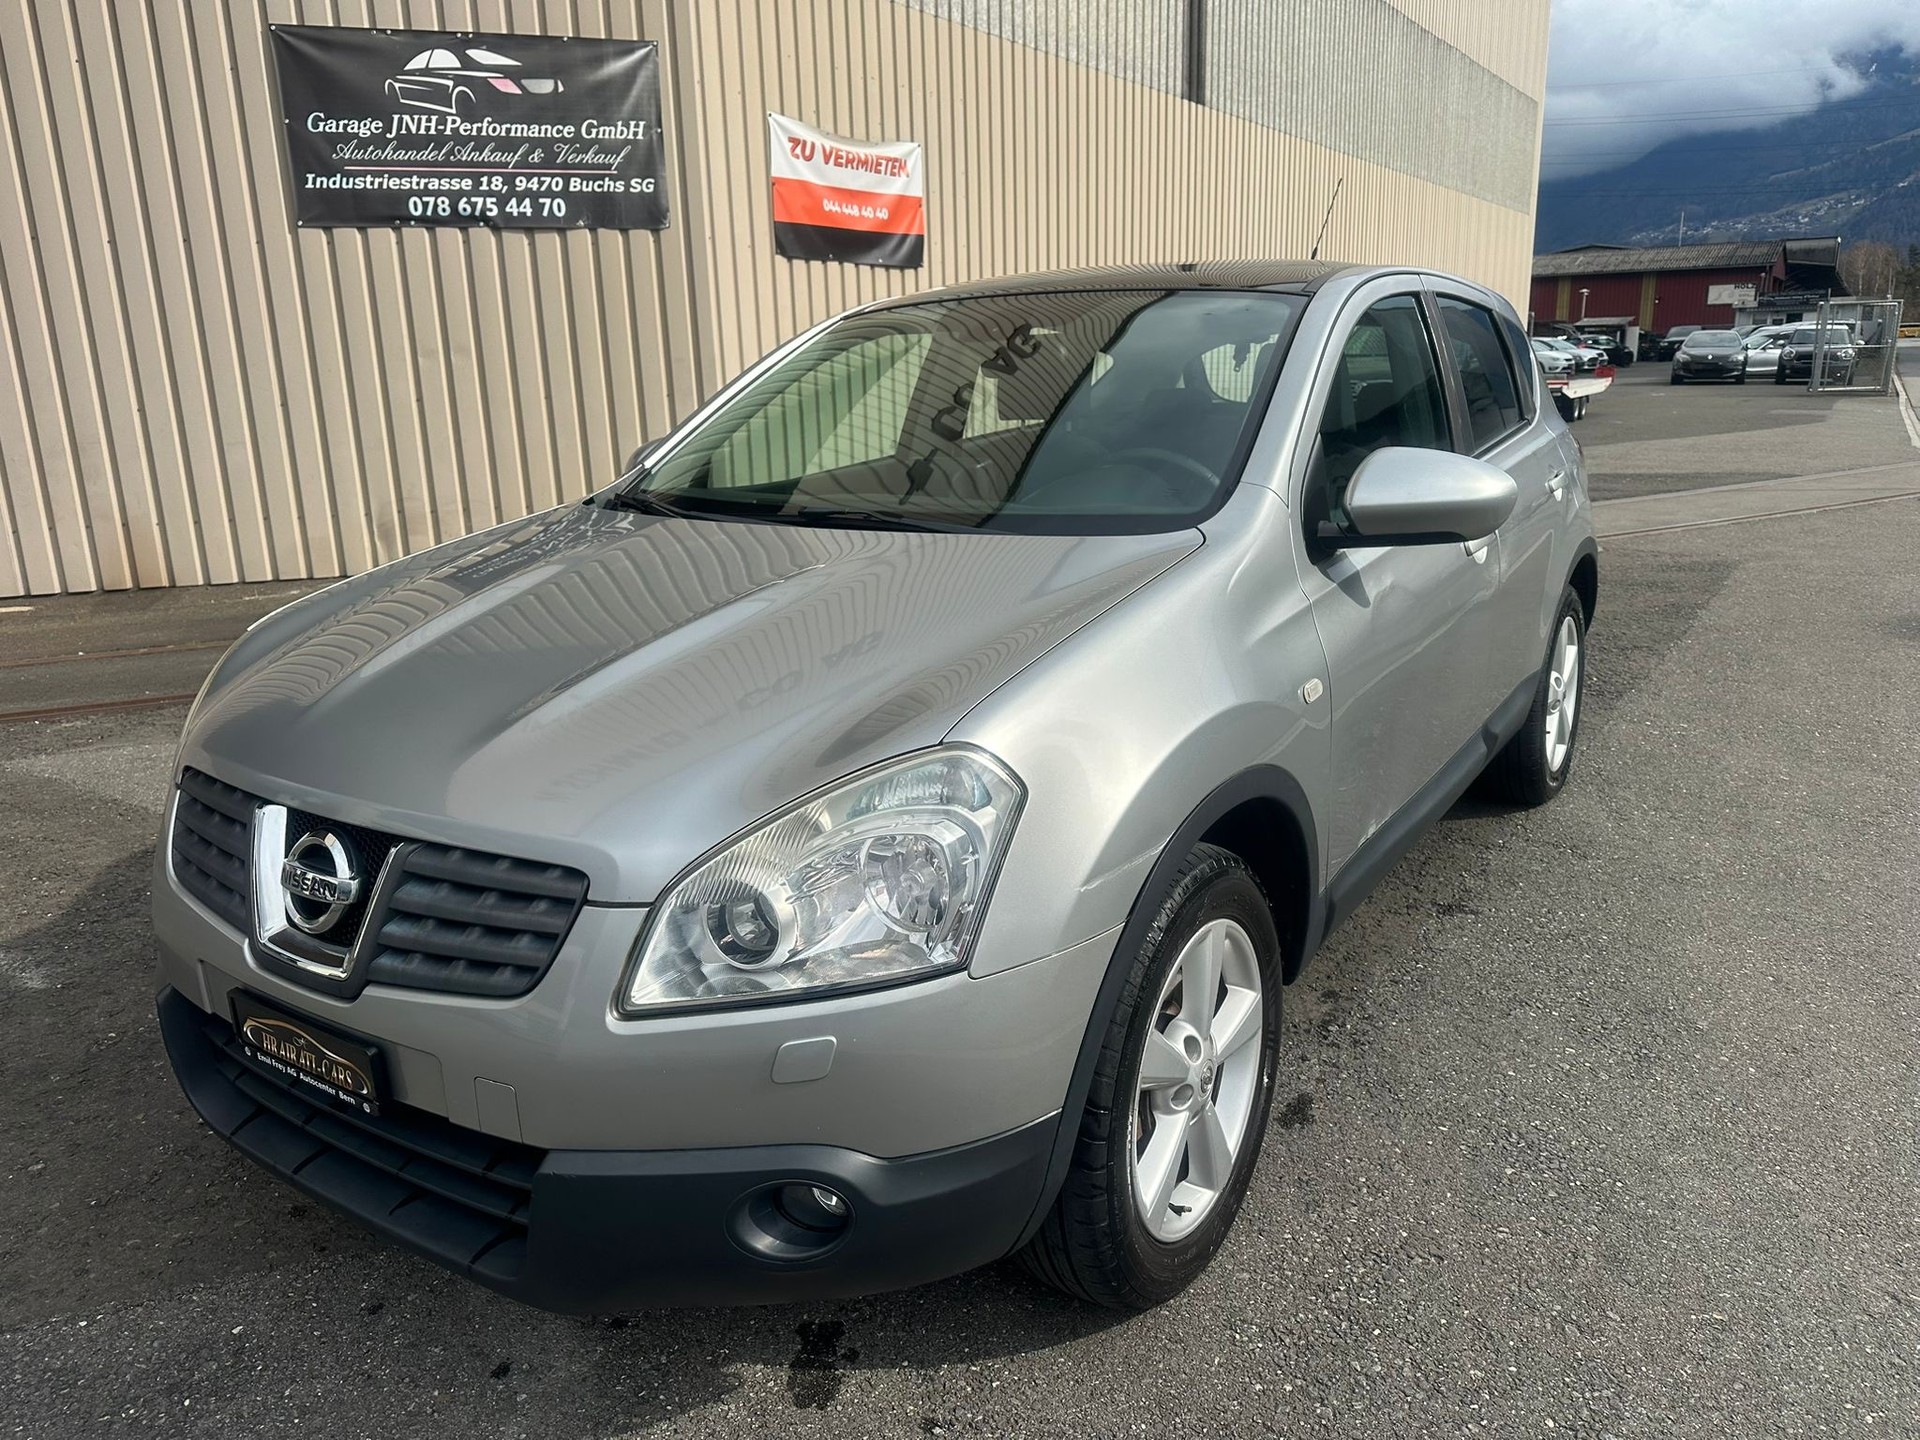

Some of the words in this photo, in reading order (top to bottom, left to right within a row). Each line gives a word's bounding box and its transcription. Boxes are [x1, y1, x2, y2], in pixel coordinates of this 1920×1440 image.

[306, 111, 383, 138] Garage
[386, 114, 576, 139] JNH-Performance
[581, 119, 646, 140] GmbH
[332, 139, 454, 162] Autohandel
[450, 141, 529, 169] Ankauf
[528, 148, 545, 163] &
[553, 143, 632, 170] Verkauf
[788, 136, 815, 162] ZU
[821, 143, 910, 178] VERMIETEN
[304, 173, 473, 190] Industriestrasse
[479, 175, 509, 194] 18,
[514, 177, 563, 192] 9470
[569, 177, 625, 193] Buchs
[629, 178, 656, 193] SG
[408, 196, 451, 216] 078
[457, 197, 499, 217] 675
[505, 197, 533, 217] 44
[539, 198, 566, 217] 70
[823, 198, 841, 213] 044
[842, 202, 859, 217] 448
[861, 205, 874, 219] 40
[876, 207, 889, 220] 40
[282, 864, 339, 901] NISSAN
[271, 1058, 286, 1073] Frey
[287, 1066, 297, 1077] AG
[300, 1072, 335, 1096] Autocenter
[338, 1090, 356, 1105] Bern
